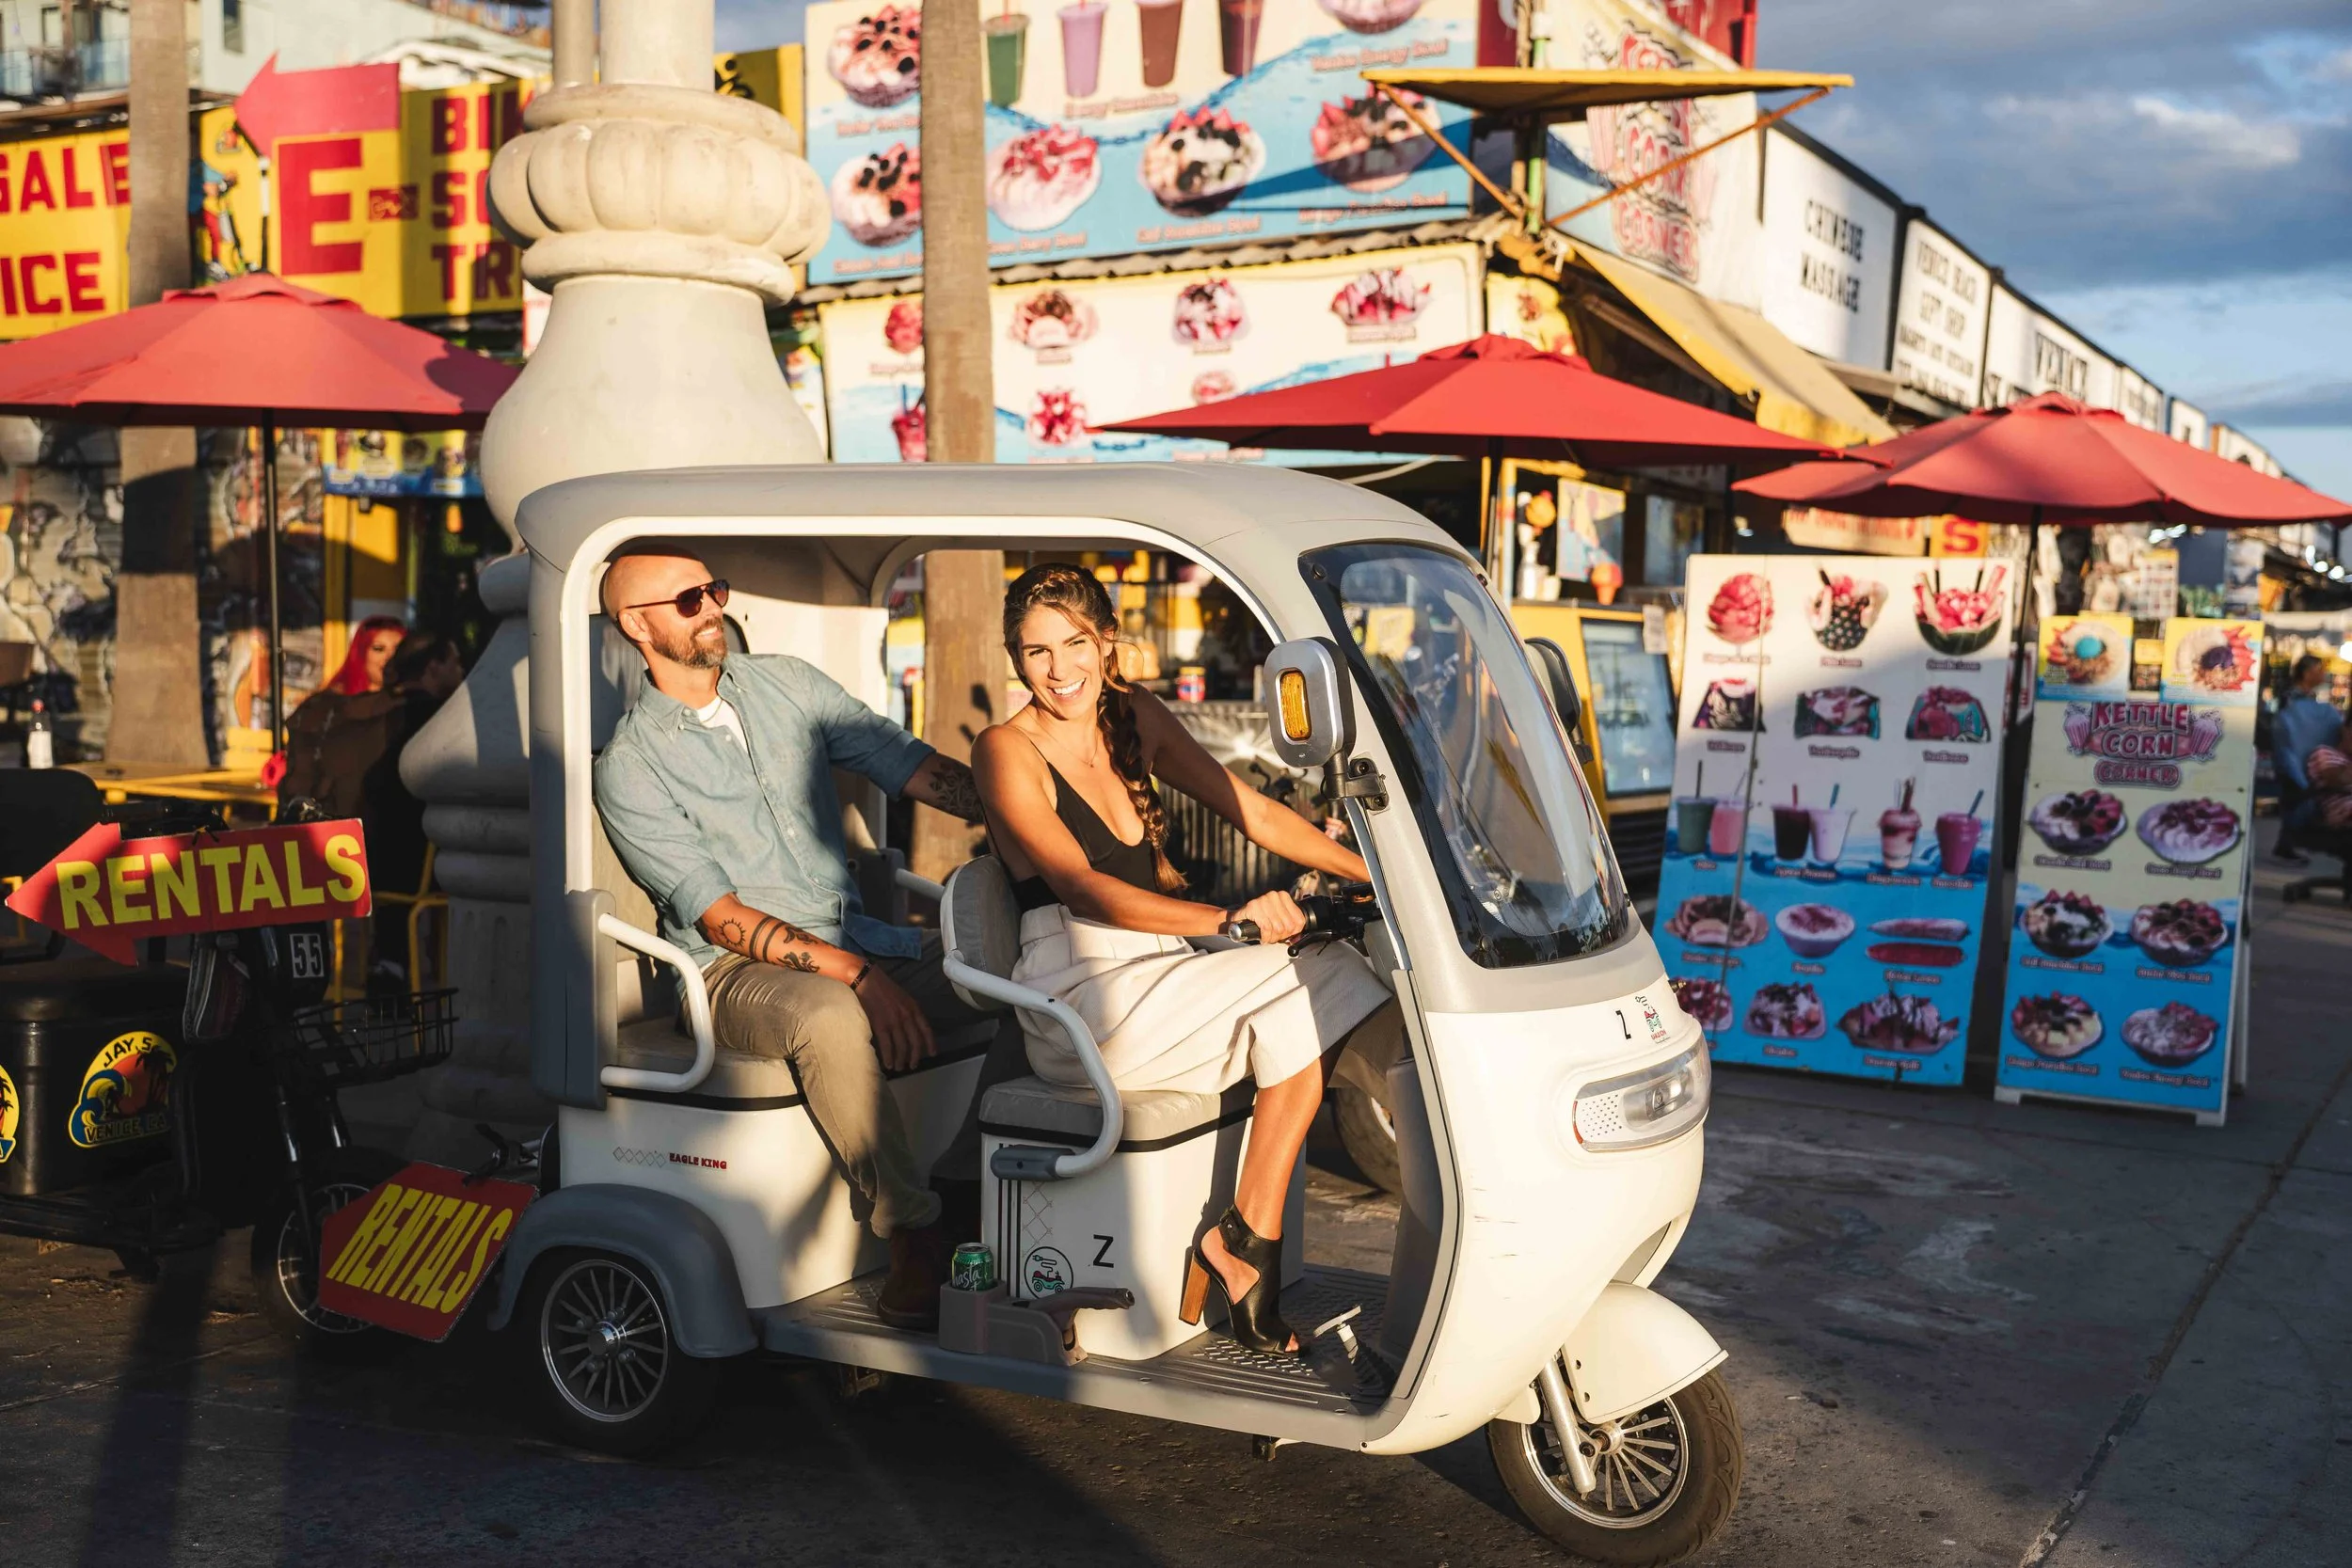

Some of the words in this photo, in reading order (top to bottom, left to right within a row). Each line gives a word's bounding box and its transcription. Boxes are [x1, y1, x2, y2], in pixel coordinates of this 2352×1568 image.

[278, 138, 363, 276] E
[432, 171, 490, 230] S
[1805, 199, 1867, 263] CHINESE
[0, 251, 105, 316] ICE
[1801, 251, 1861, 313] MASSAGE
[2091, 702, 2190, 734] KETTLE
[2103, 730, 2176, 756] CORN
[2097, 761, 2180, 785] CORNER
[56, 834, 366, 929] RENTALS
[292, 935, 323, 976] 55
[669, 1152, 699, 1166] EAGLE
[701, 1158, 727, 1170] KING
[326, 1183, 514, 1314] RENTALS
[1092, 1234, 1114, 1268] Z
